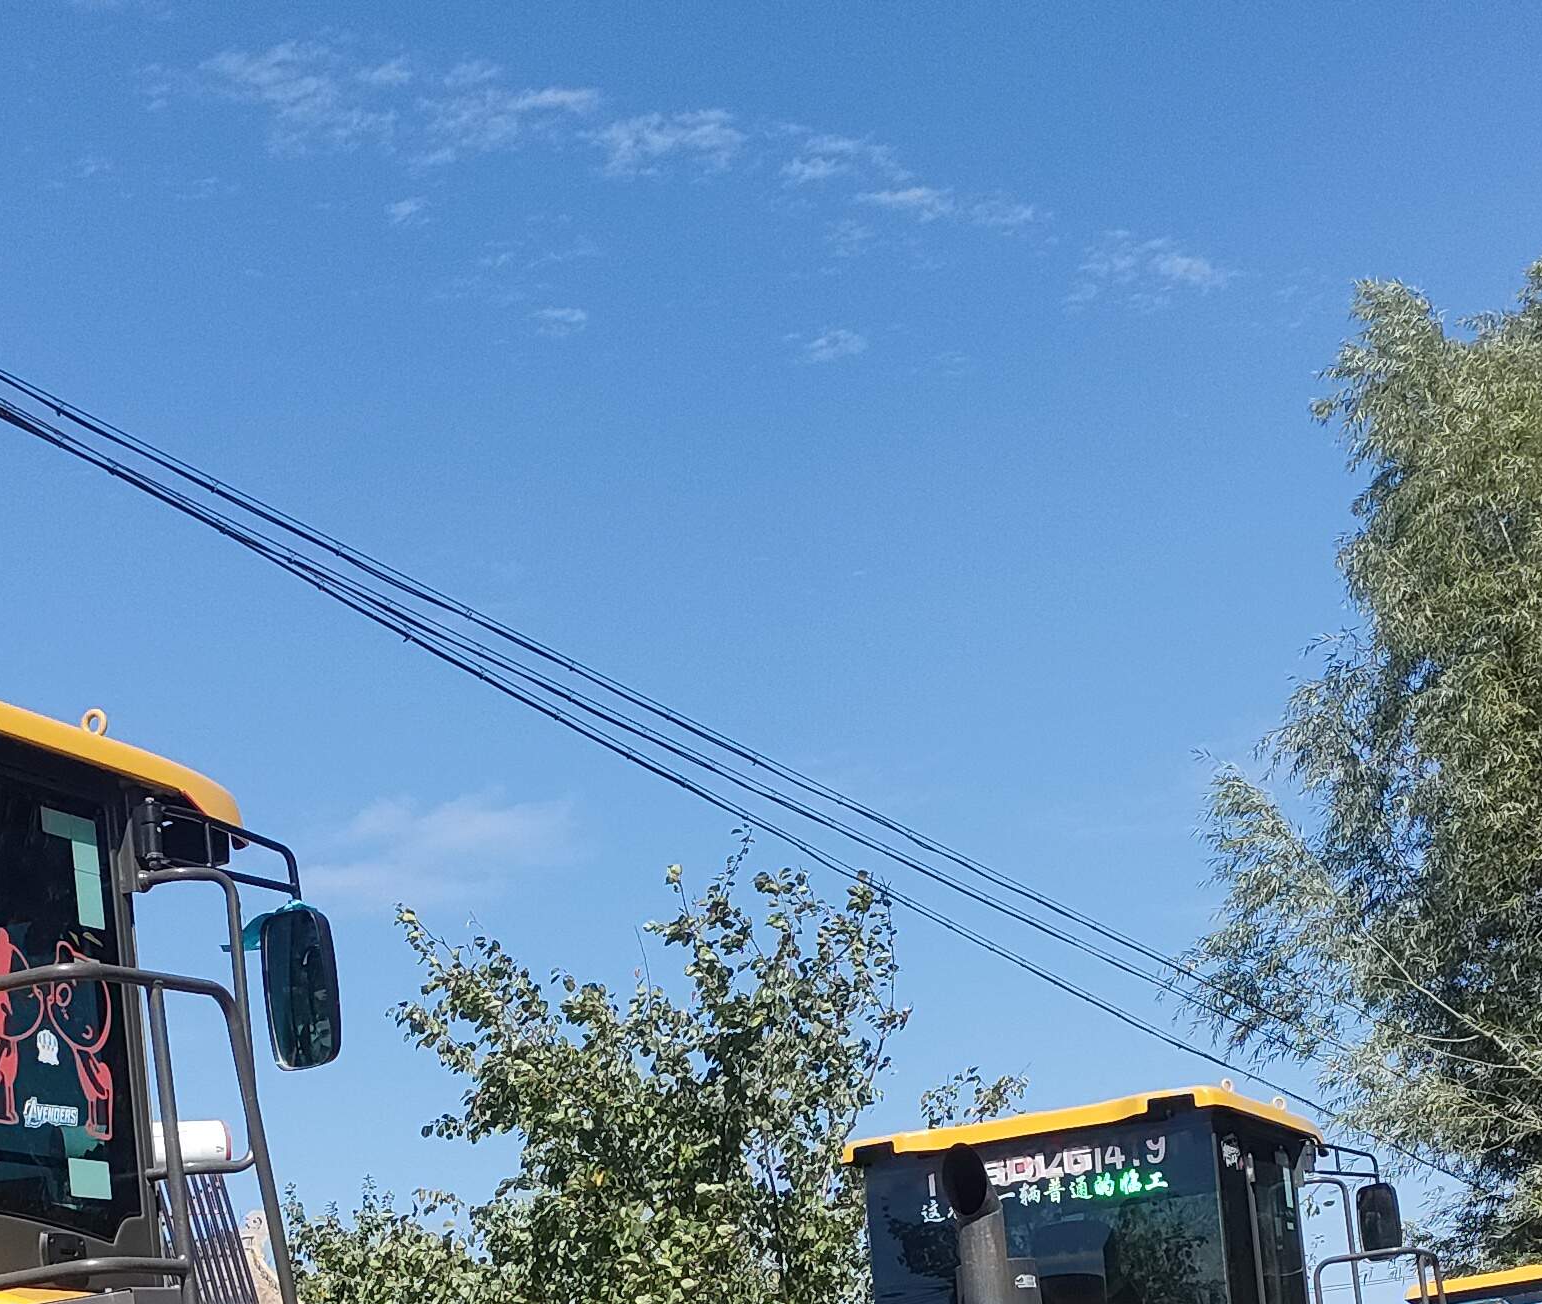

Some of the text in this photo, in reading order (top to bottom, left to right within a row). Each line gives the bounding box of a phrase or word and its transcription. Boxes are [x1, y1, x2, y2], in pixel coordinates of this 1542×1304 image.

[921, 1169, 1169, 1223] 这一辆普通的临工
